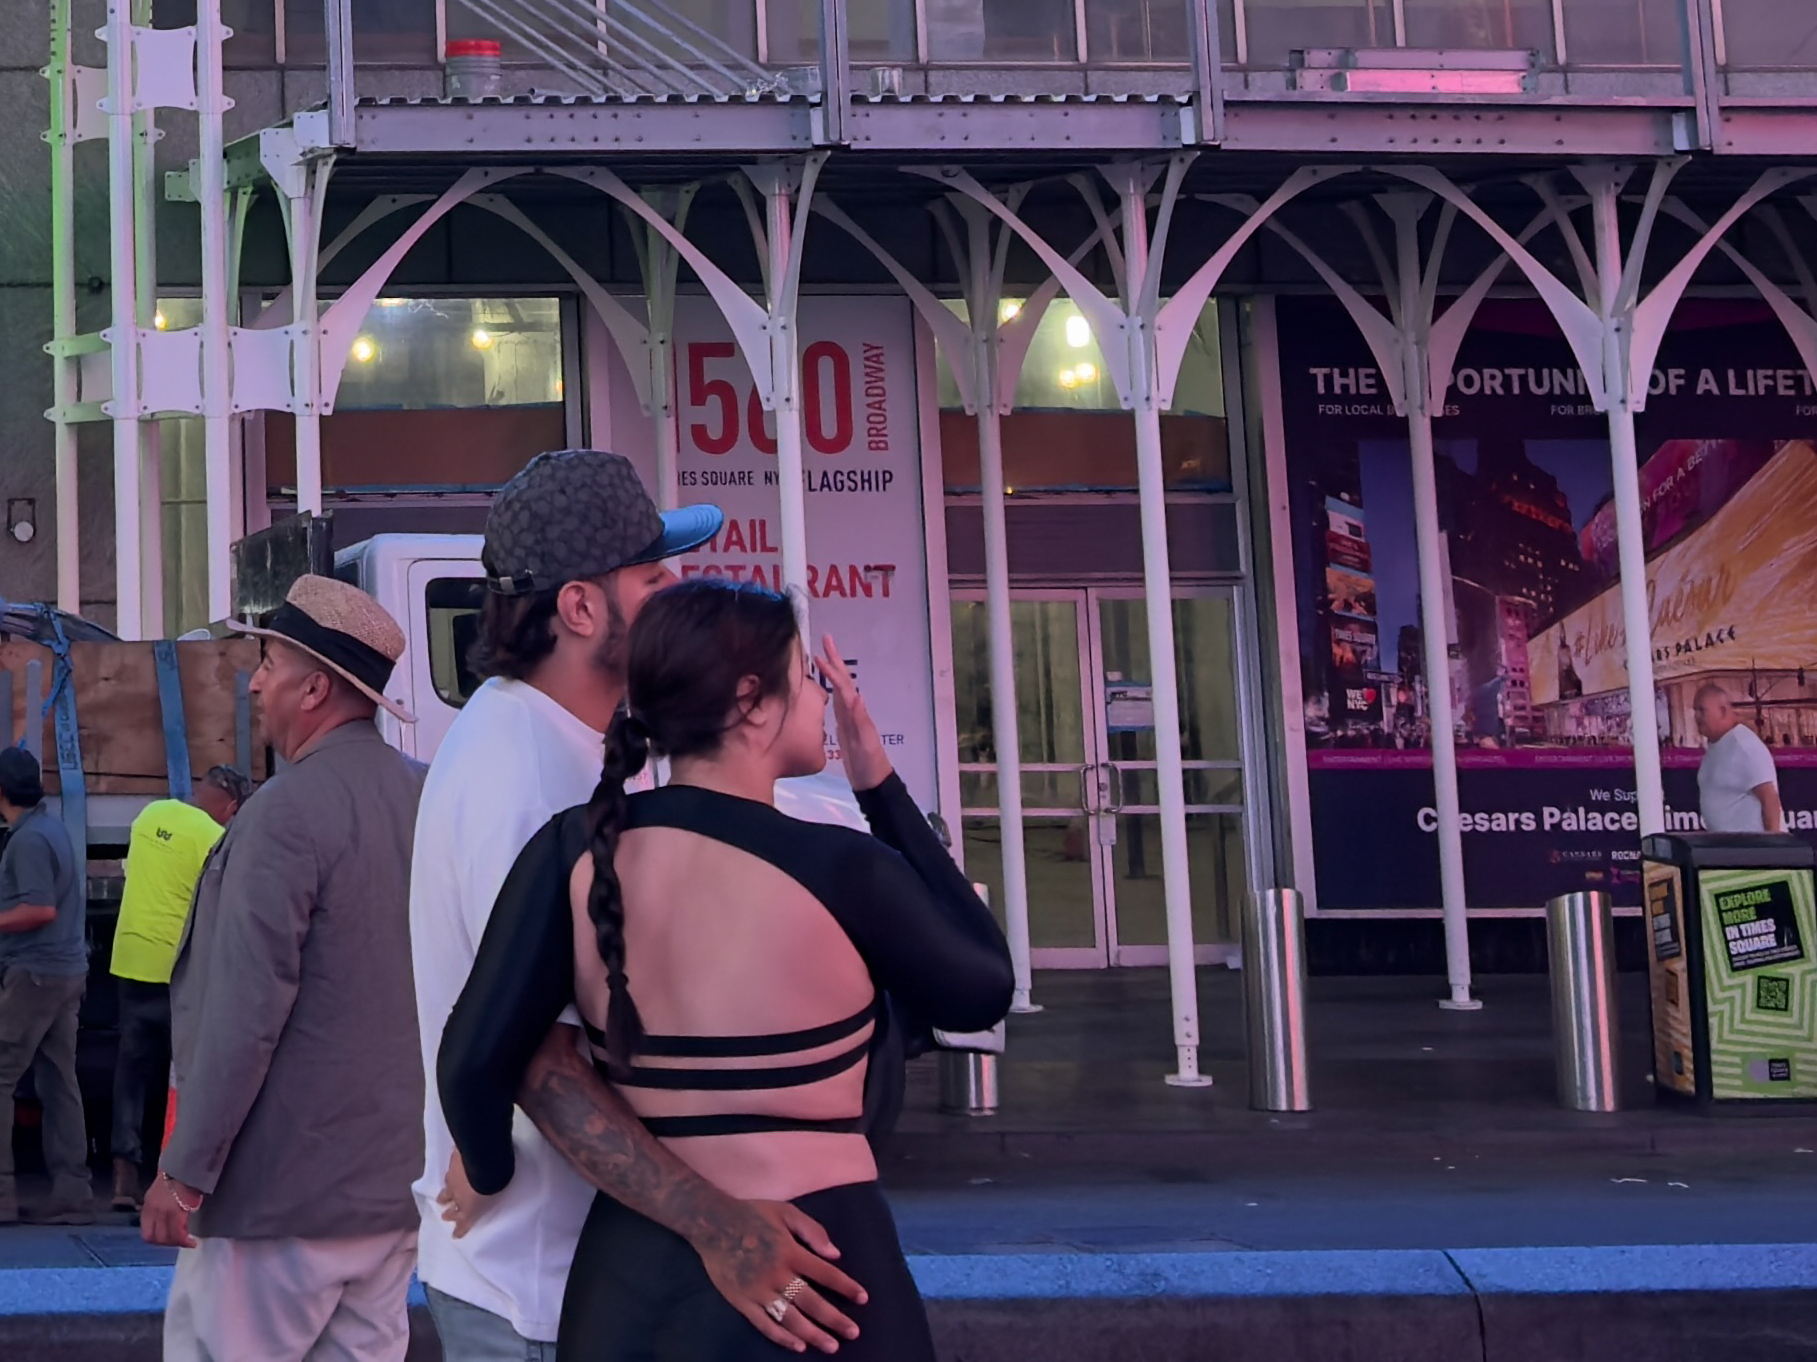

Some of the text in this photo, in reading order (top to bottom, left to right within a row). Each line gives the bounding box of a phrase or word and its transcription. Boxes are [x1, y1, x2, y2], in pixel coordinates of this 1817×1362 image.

[1309, 367, 1378, 396] THE
[1696, 368, 1720, 396] A
[862, 342, 890, 452] BROADWAY
[1318, 404, 1343, 416] FOR
[1345, 404, 1384, 416] LOCAL
[701, 469, 894, 493] SQUARE LAGSHIP
[1589, 788, 1611, 801] We
[1417, 807, 1536, 832] Cesars
[1542, 805, 1639, 832] Palace
[1718, 888, 1772, 911] EXPLORE
[1722, 906, 1757, 925] MORE
[1724, 918, 1777, 940] IN TIMES
[1728, 933, 1778, 956] SQUARE
